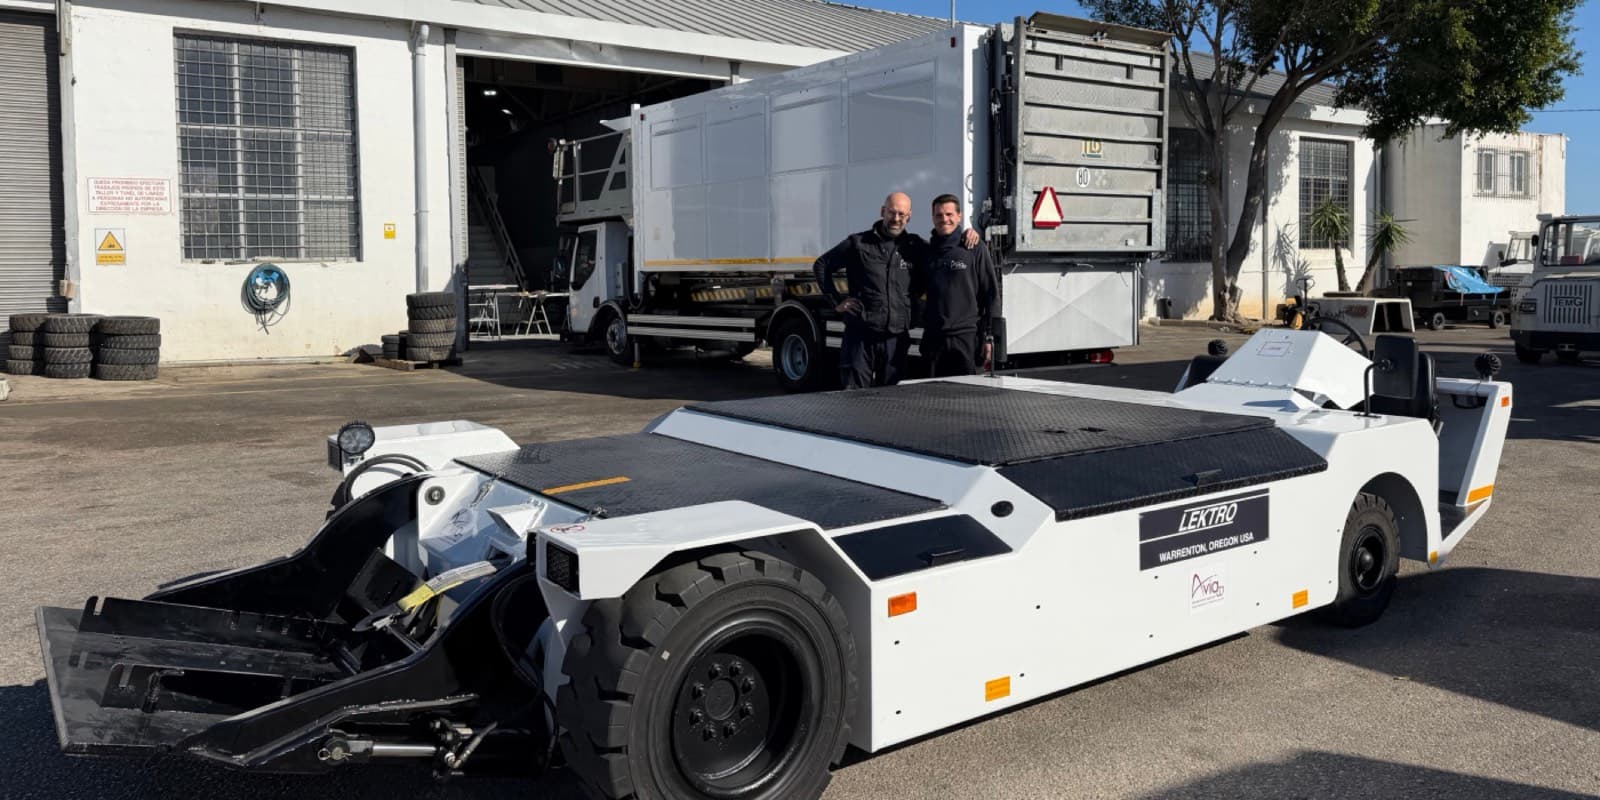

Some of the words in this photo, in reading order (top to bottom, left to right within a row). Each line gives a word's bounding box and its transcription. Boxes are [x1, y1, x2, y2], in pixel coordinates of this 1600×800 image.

[1179, 502, 1238, 532] LEKTRO
[1159, 543, 1207, 562] WARRENTON,
[1208, 536, 1239, 551] OREGON
[1240, 531, 1254, 543] USA
